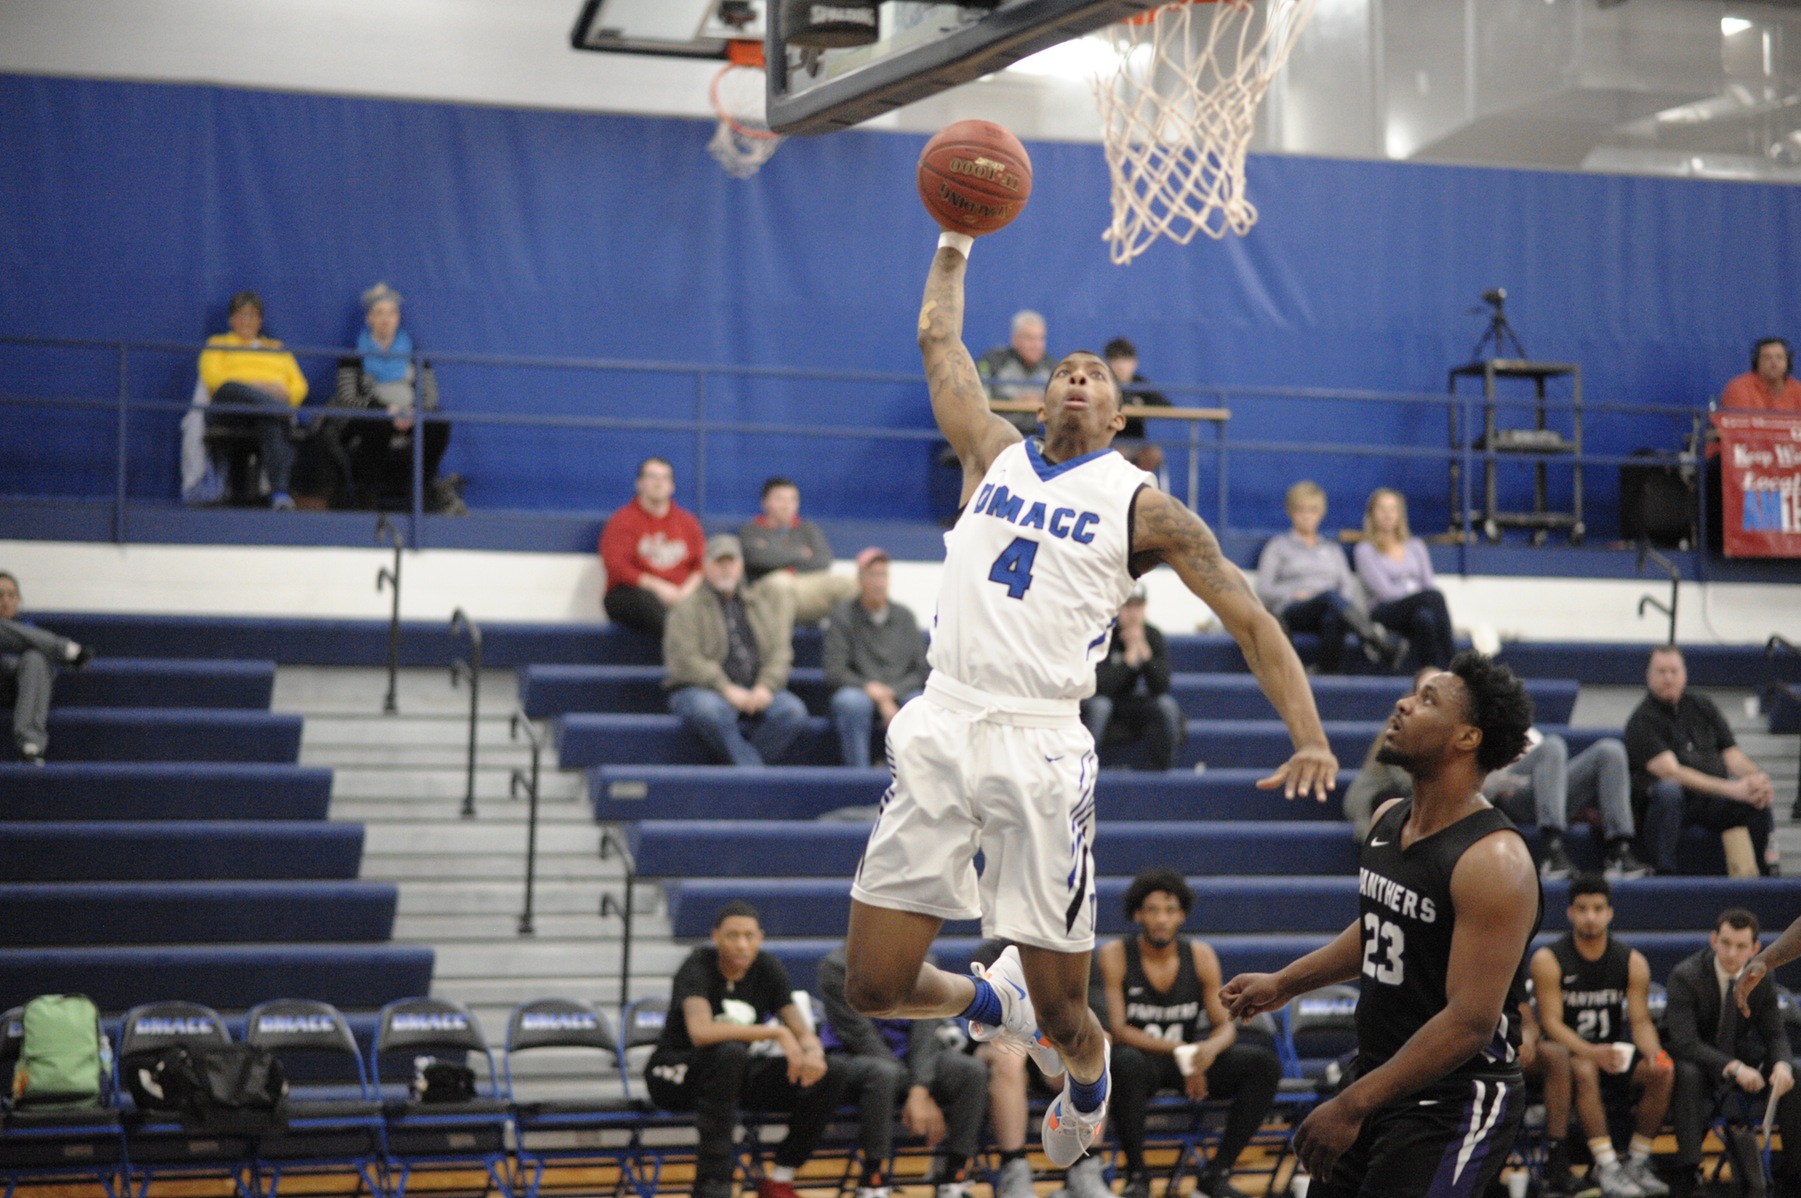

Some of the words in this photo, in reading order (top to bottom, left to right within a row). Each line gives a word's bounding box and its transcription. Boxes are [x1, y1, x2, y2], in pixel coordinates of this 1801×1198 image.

[974, 483, 1100, 545] DMACC
[988, 536, 1039, 600] 4
[1362, 912, 1405, 986] 23
[1577, 1009, 1611, 1038] 21
